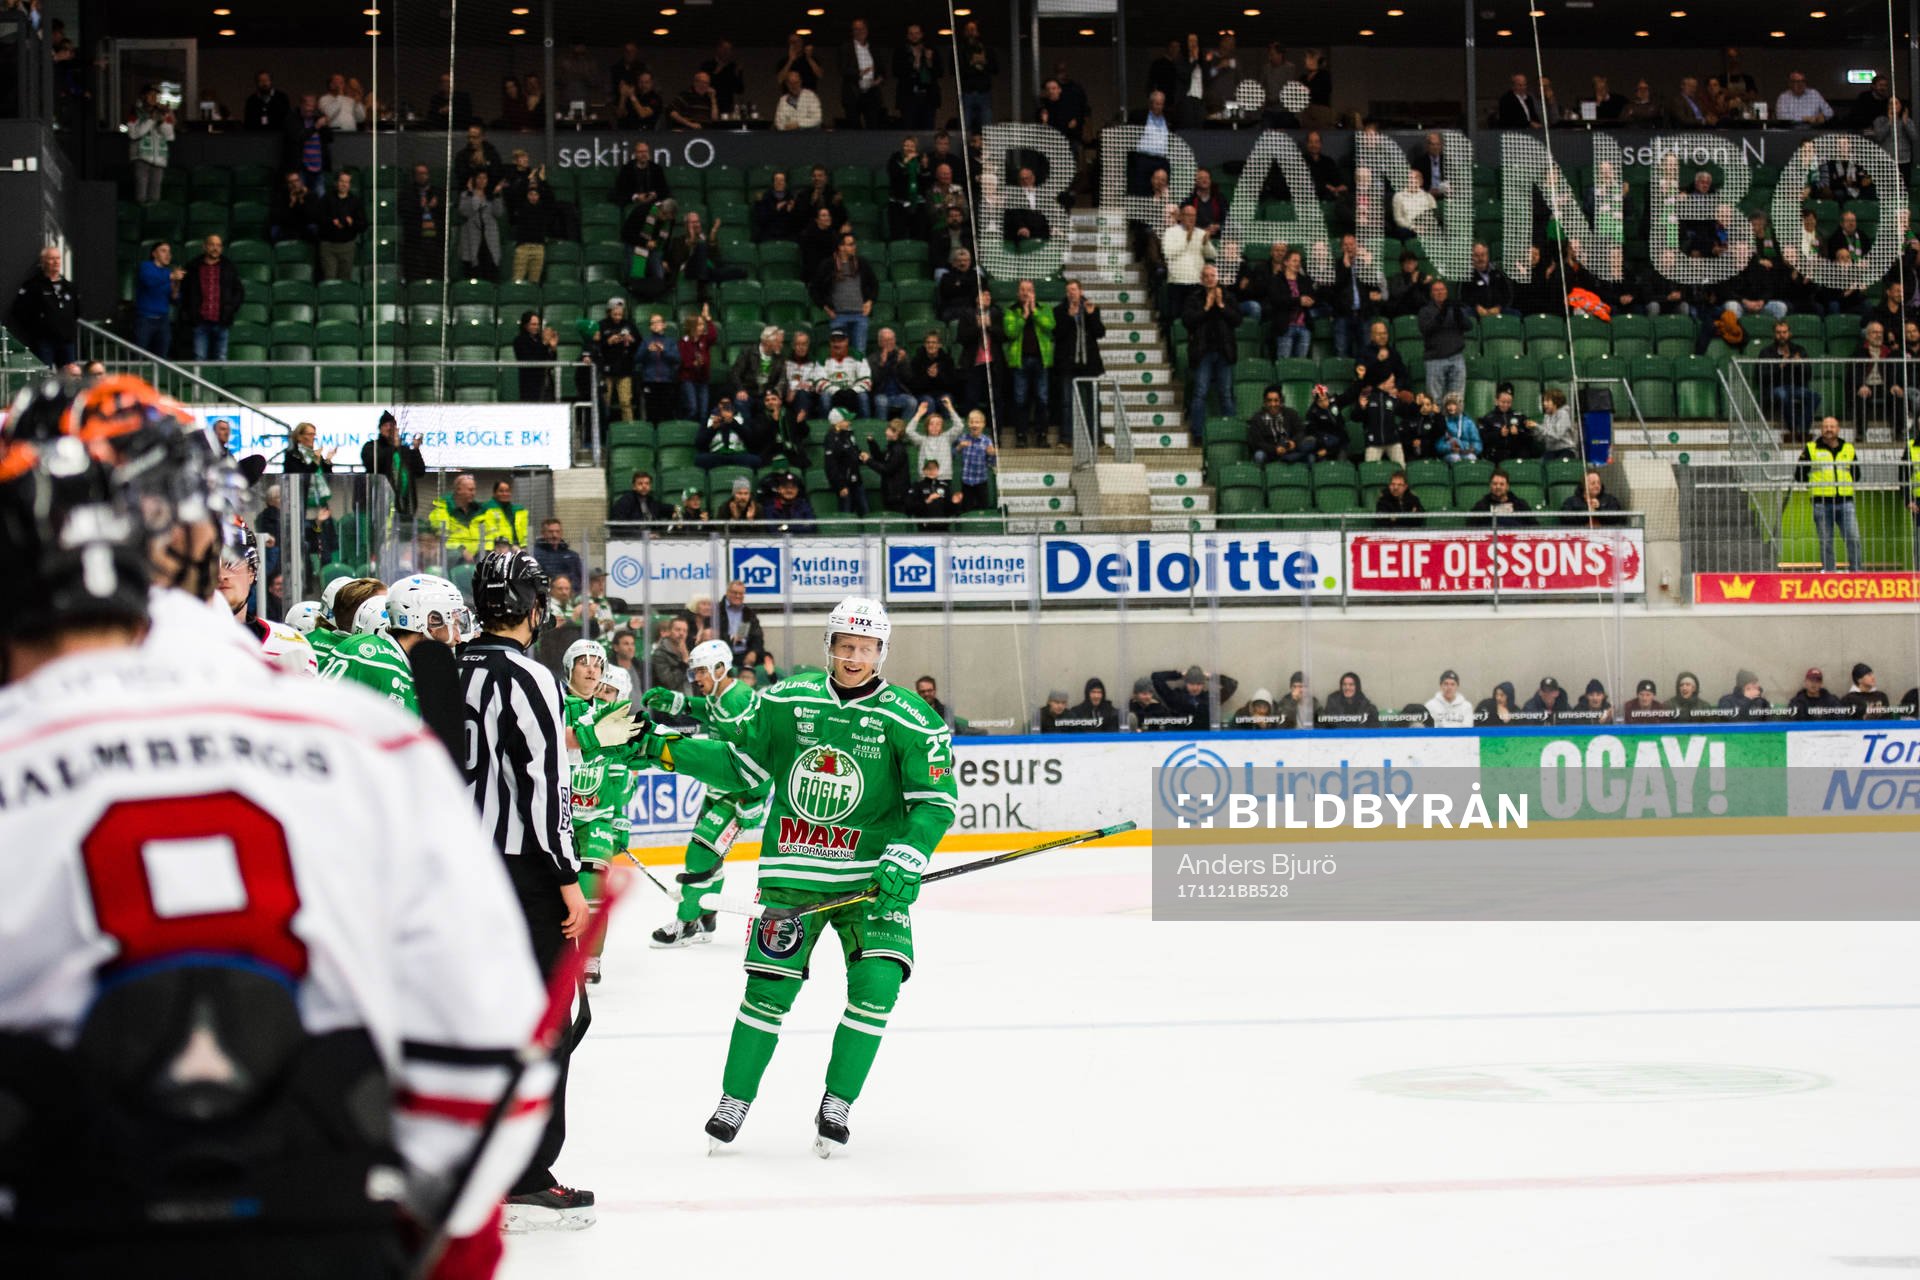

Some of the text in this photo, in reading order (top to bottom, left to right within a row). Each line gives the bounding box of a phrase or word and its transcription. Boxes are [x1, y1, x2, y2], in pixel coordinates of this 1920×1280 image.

[558, 137, 715, 168] sektin O
[1742, 137, 1765, 165] N
[977, 80, 1909, 290] BRÄNNBO
[455, 429, 514, 447] RÖGLE
[898, 565, 928, 583] KP
[1360, 541, 1607, 578] LEIF OLSSONS
[742, 567, 773, 584] KP
[1522, 575, 1547, 589] AB
[784, 680, 822, 691] Lindab
[895, 696, 927, 727] Lindab
[926, 734, 952, 763] 27
[0, 733, 333, 810] ALMBERGS
[952, 752, 1063, 787] esurs
[1244, 759, 1414, 802] Lindab
[1540, 734, 1729, 819] OCAY!
[799, 776, 853, 803] RÖGLE
[959, 793, 1037, 830] ank
[778, 817, 862, 850] MAXI
